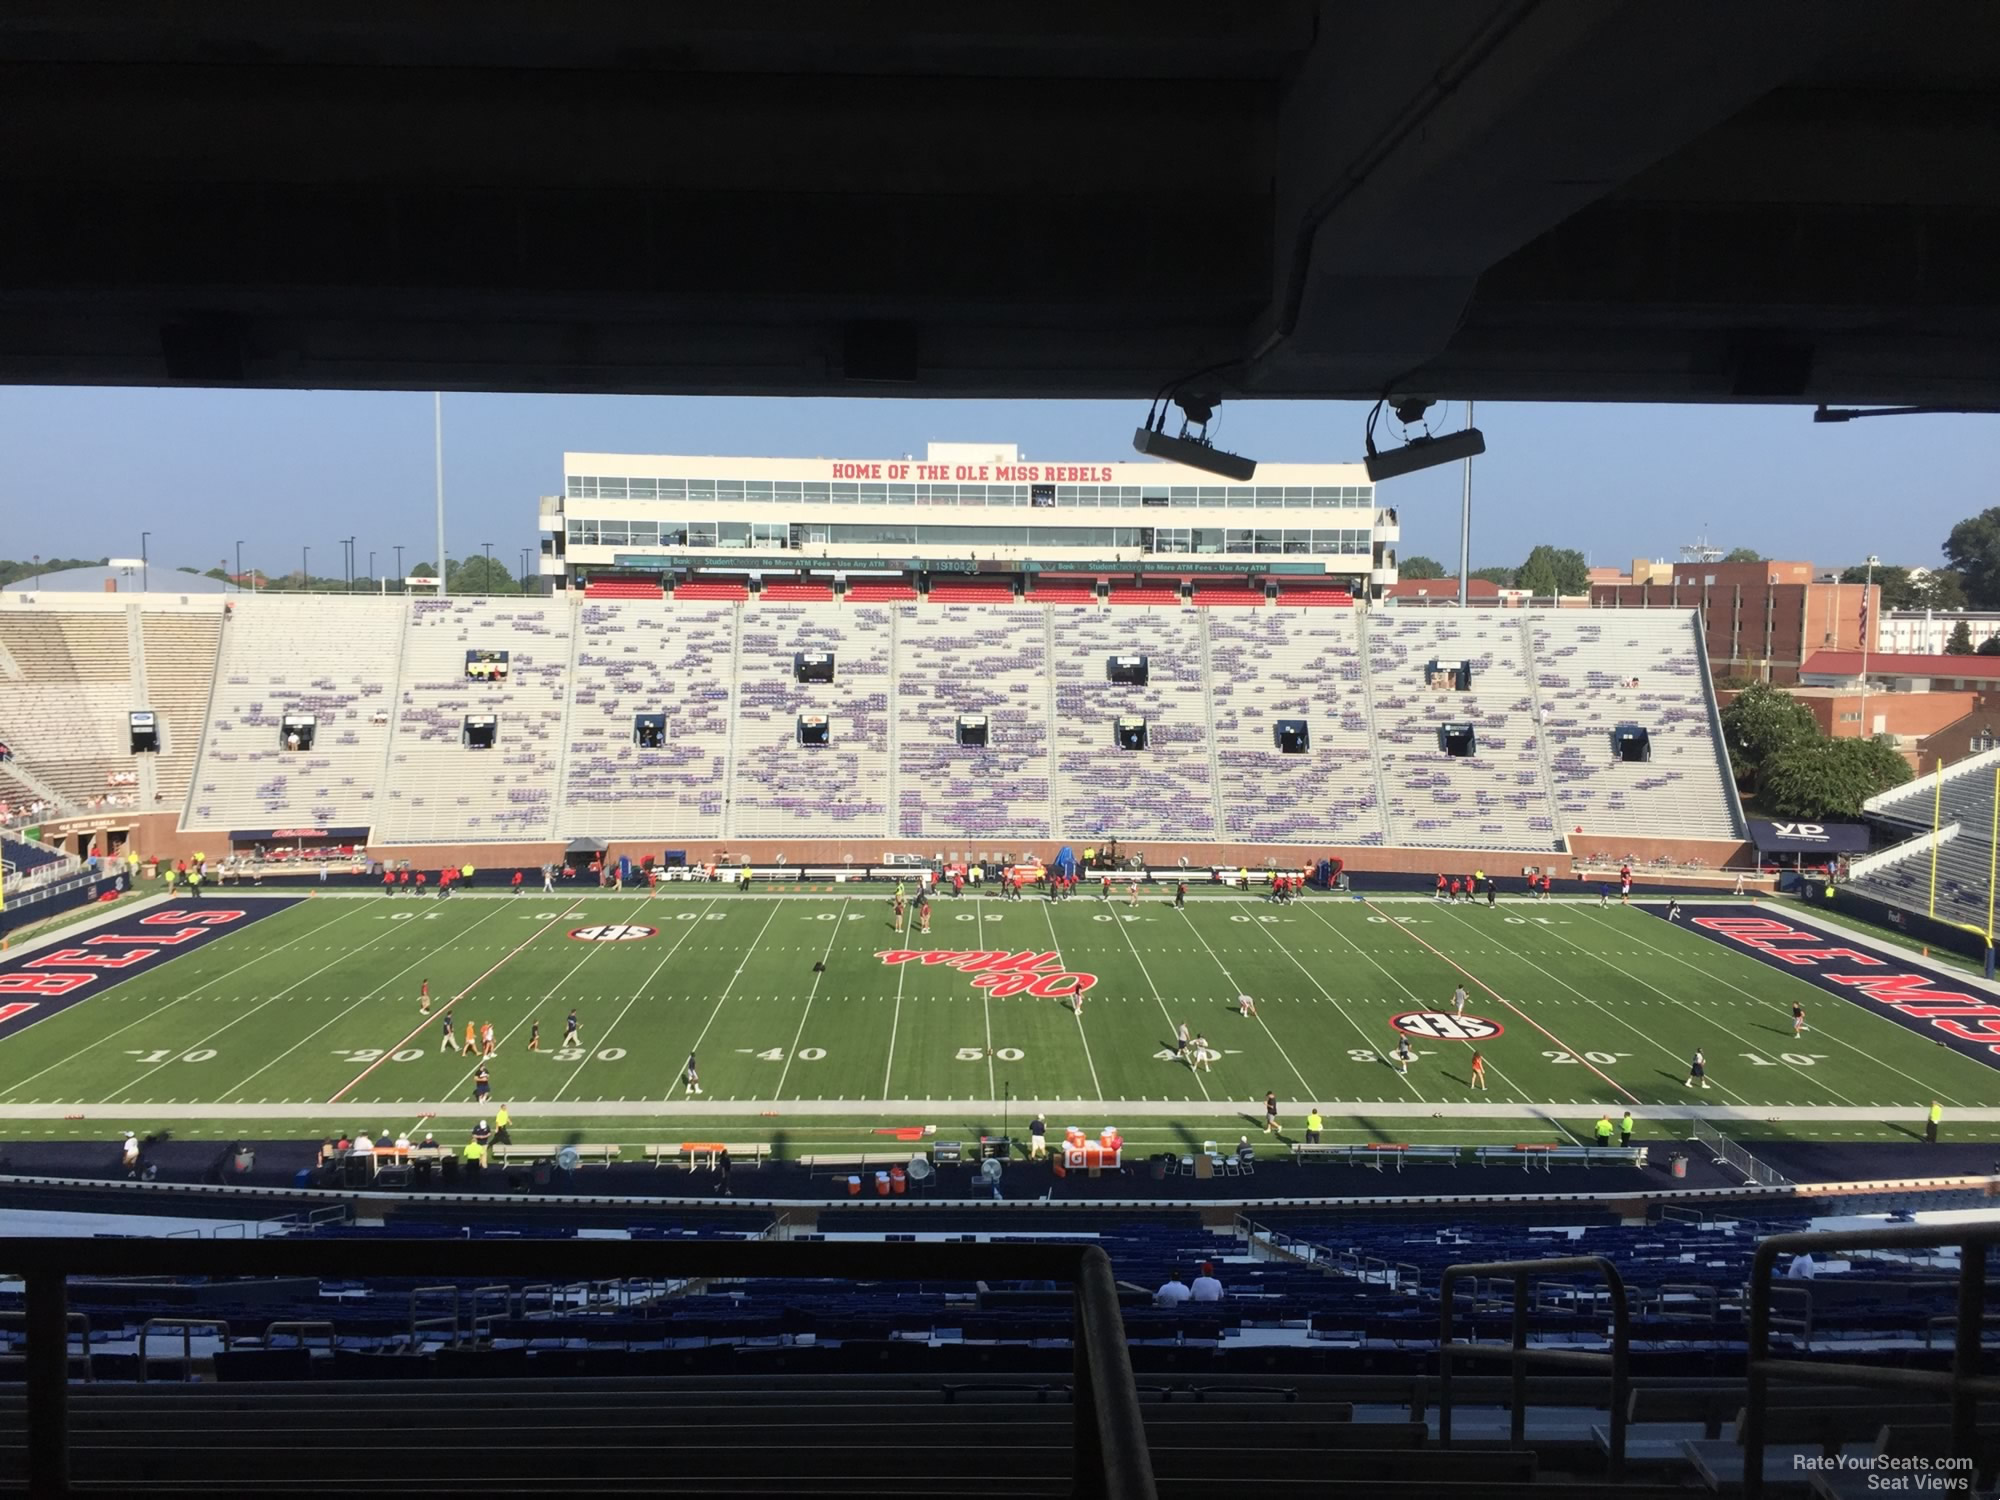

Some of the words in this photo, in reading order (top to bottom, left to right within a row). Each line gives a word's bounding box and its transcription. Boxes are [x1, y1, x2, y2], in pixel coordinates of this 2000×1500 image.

[832, 463, 882, 479] HOME
[888, 464, 910, 480] OF
[917, 465, 950, 480] THE
[955, 465, 989, 481] OLE
[995, 466, 1039, 481] MISS
[1045, 466, 1112, 482] REBELS
[762, 559, 772, 567] No
[774, 559, 792, 567] More
[813, 560, 830, 568] Fees
[852, 561, 867, 570] Any
[1144, 564, 1154, 572] No
[1156, 564, 1175, 572] More
[1176, 564, 1193, 572] ATM
[1194, 565, 1212, 573] Fees
[1219, 565, 1233, 573] Use
[1235, 565, 1249, 574] Any
[1250, 565, 1267, 573] ATM
[1771, 822, 1825, 835] yp
[390, 911, 445, 921] 10
[534, 911, 588, 921] 20
[675, 912, 728, 921] 30
[816, 912, 867, 922] 40
[955, 913, 1004, 922] 50
[1092, 914, 1142, 923] 40
[1230, 914, 1279, 923] 30
[1366, 915, 1418, 924] 20
[1503, 915, 1554, 925] 10
[873, 949, 1066, 972] Miss
[970, 972, 1098, 997] Ole
[1691, 917, 1888, 965] OLE
[1820, 973, 2000, 1054] MIS
[1398, 1011, 1498, 1038] SEC
[135, 1049, 218, 1063] 10
[344, 1049, 425, 1063] 20
[552, 1048, 627, 1061] 30
[756, 1048, 827, 1061] 40
[955, 1048, 1025, 1061] 50
[1153, 1048, 1222, 1061] 40
[1346, 1049, 1420, 1063] 30
[1541, 1050, 1617, 1065] 20
[1737, 1052, 1816, 1066] 10
